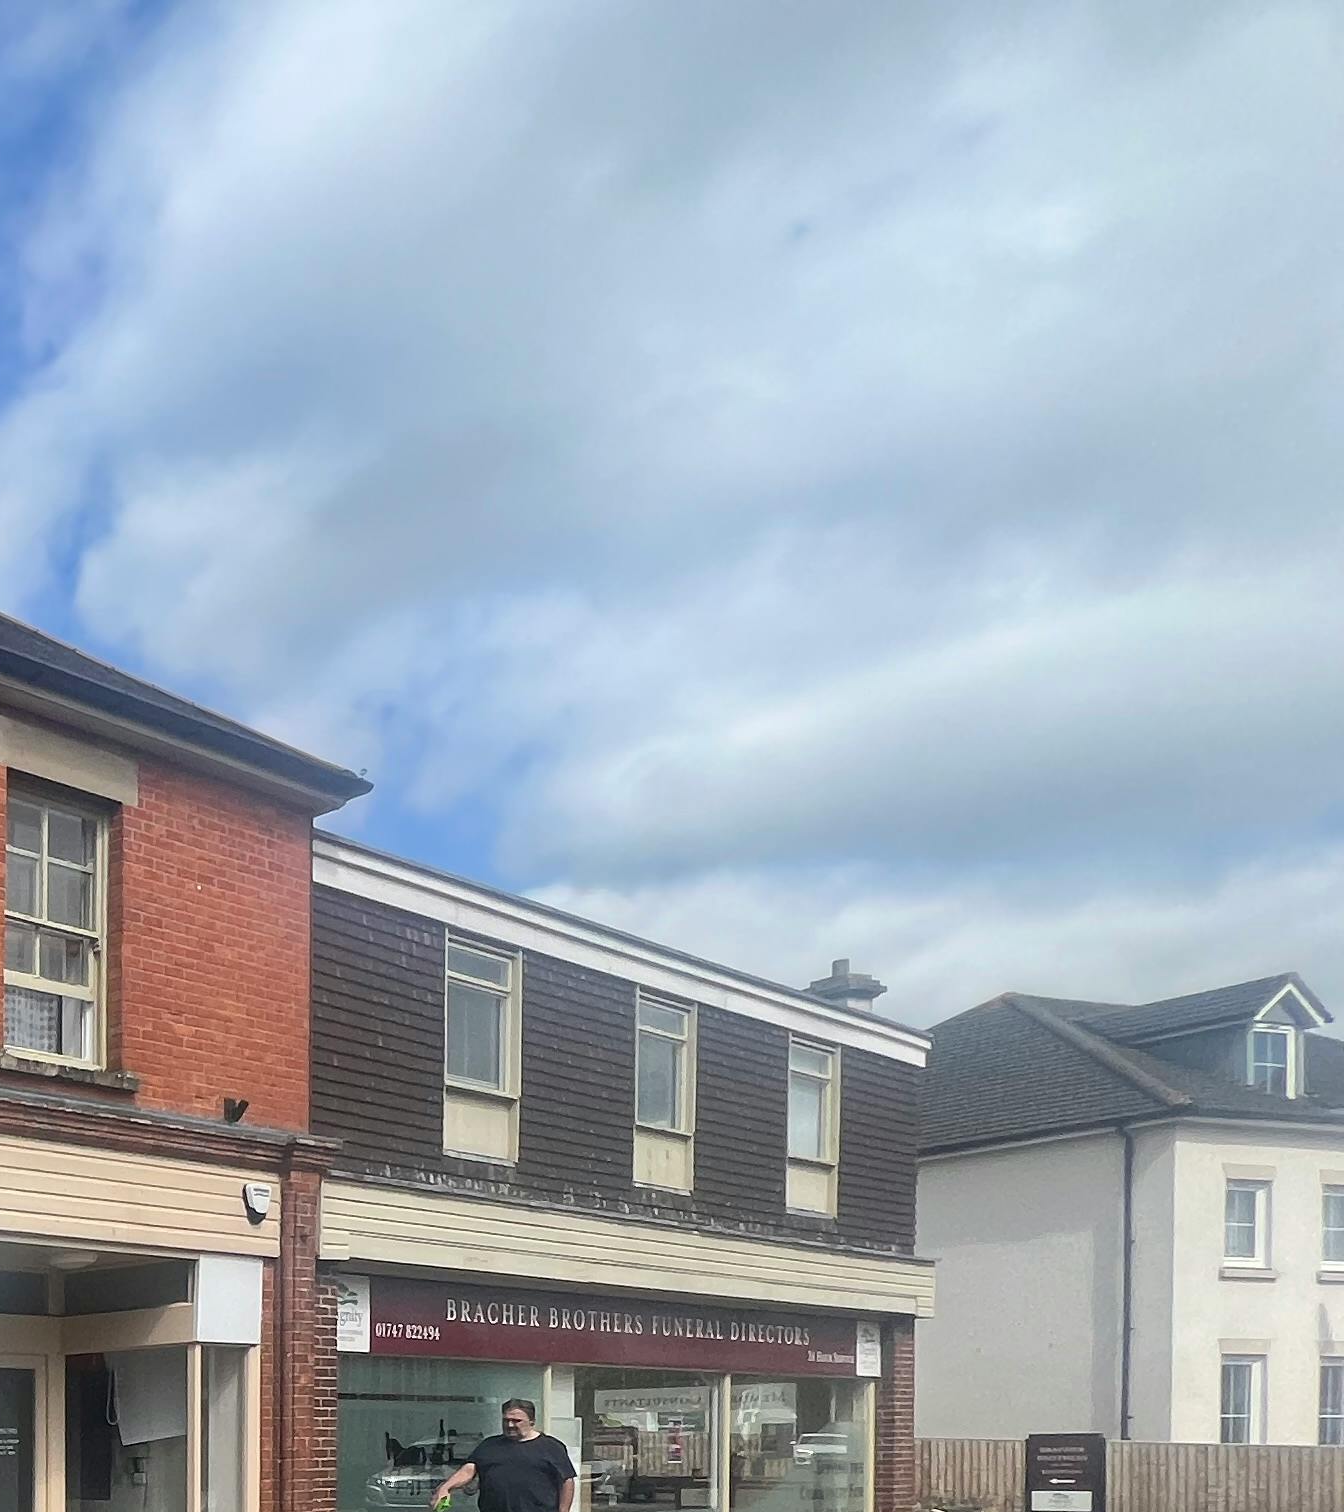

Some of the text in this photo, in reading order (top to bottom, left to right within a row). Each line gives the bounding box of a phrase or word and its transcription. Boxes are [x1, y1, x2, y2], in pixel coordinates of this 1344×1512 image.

[375, 1322, 403, 1339] 01747
[445, 1298, 811, 1347] BRACHER BROTHERS FUNERAL DIRECTORS
